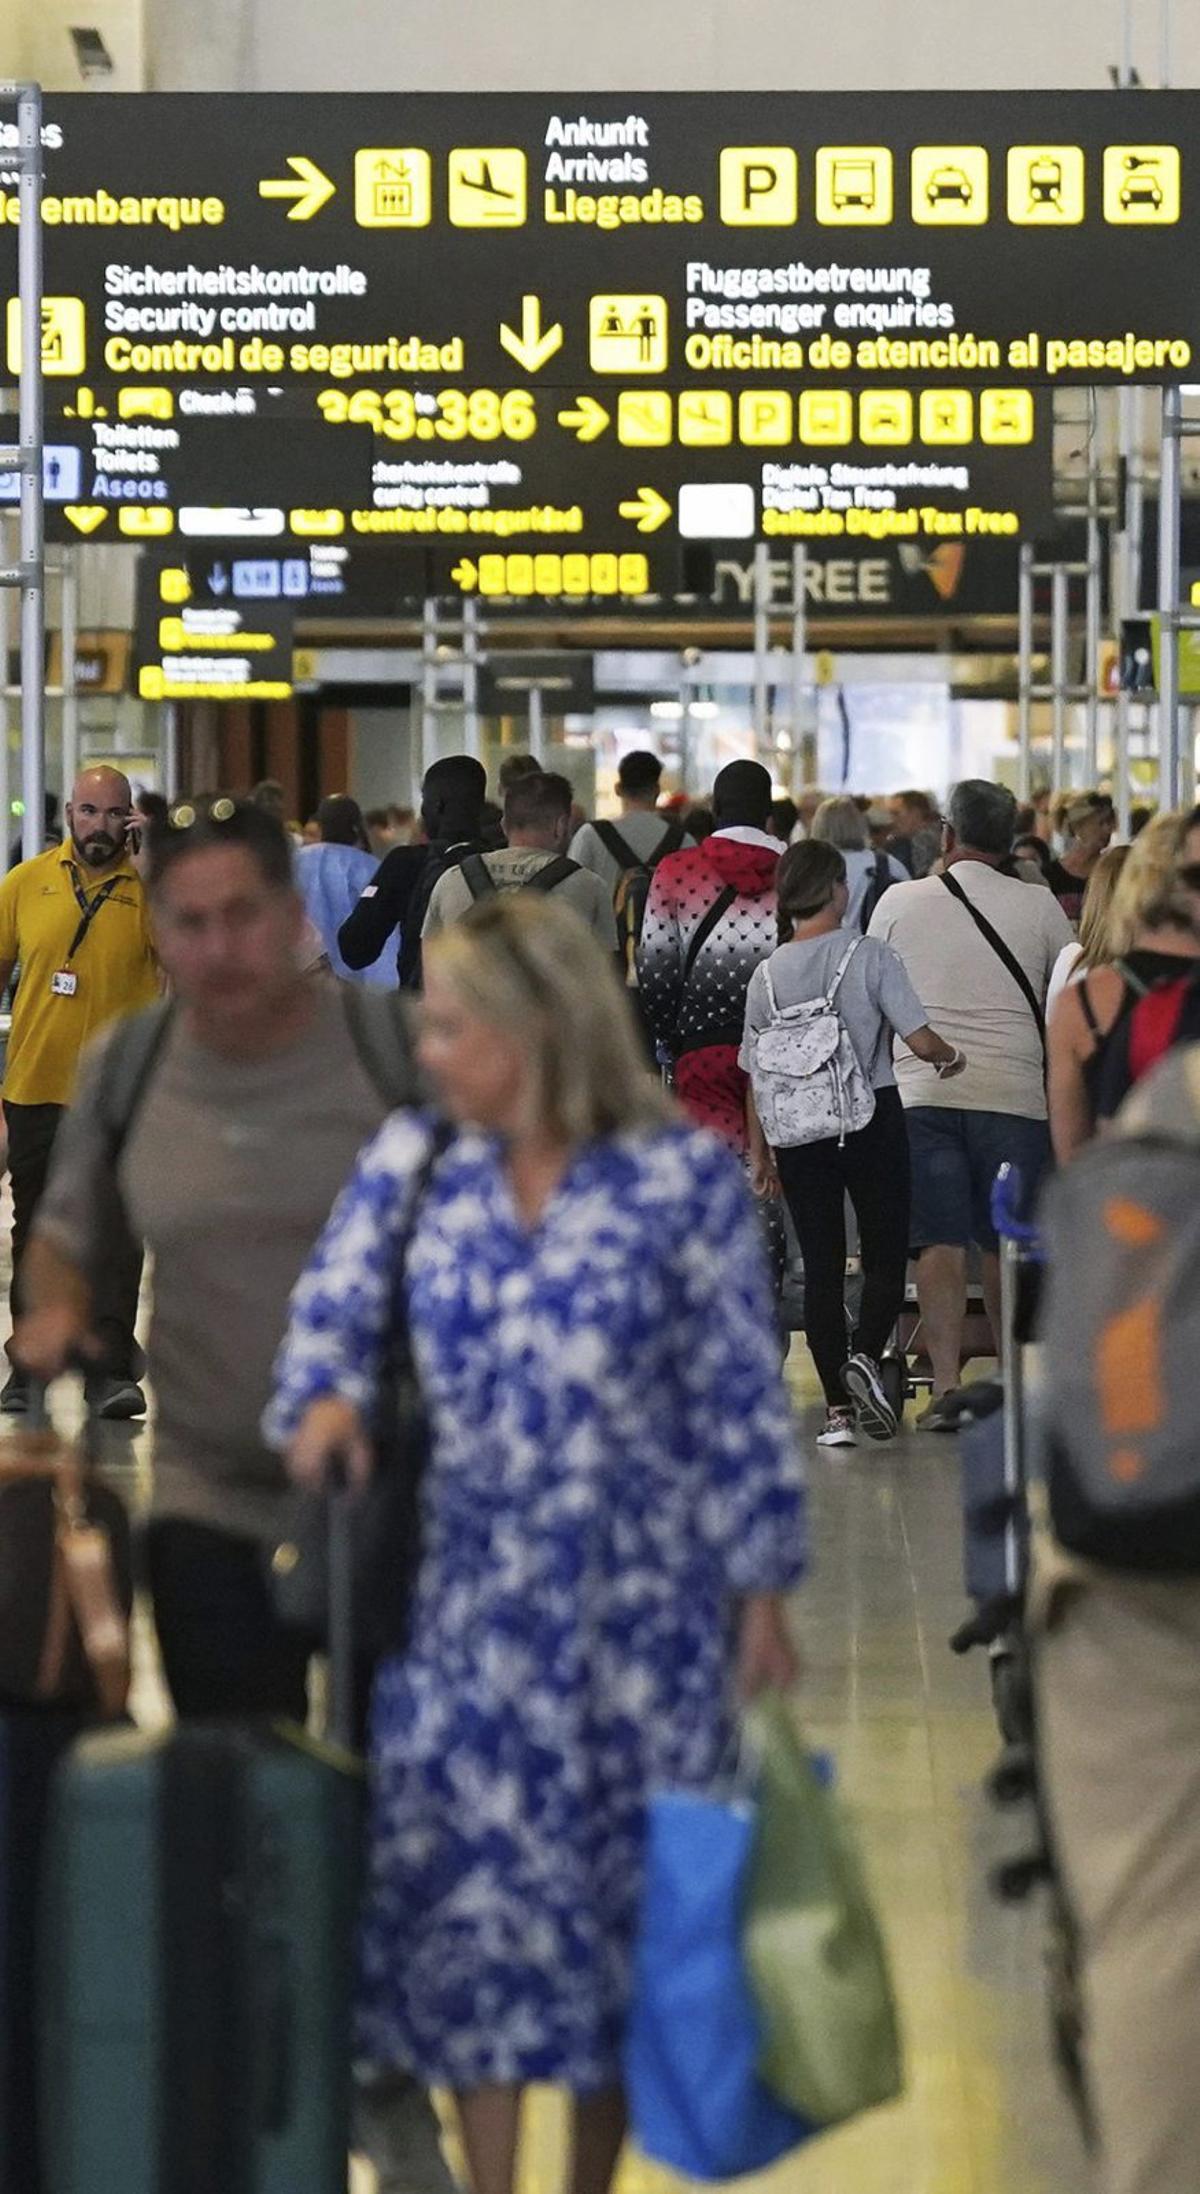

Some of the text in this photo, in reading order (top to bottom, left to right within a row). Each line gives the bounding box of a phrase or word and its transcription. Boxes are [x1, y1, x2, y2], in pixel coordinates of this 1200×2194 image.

[545, 115, 649, 147] Ankunft
[545, 152, 648, 183] Arrivals
[744, 164, 777, 210] P
[41, 189, 225, 231] embarque
[545, 188, 704, 230] Llegadas
[105, 264, 367, 296] Sicherheitskontrolle
[686, 262, 931, 297] Fluggastbetreuung
[105, 301, 315, 337] Security control
[686, 298, 955, 334] Passenger enquiries
[105, 336, 464, 378] Control de seguridad
[685, 333, 1191, 374] Oficina de atención al pasajero
[92, 422, 180, 448] Toiletten
[92, 448, 160, 473] Toilets
[92, 474, 169, 499] Aseos
[846, 508, 918, 540] Digital
[920, 507, 963, 535] Tax
[965, 507, 1019, 535] Free
